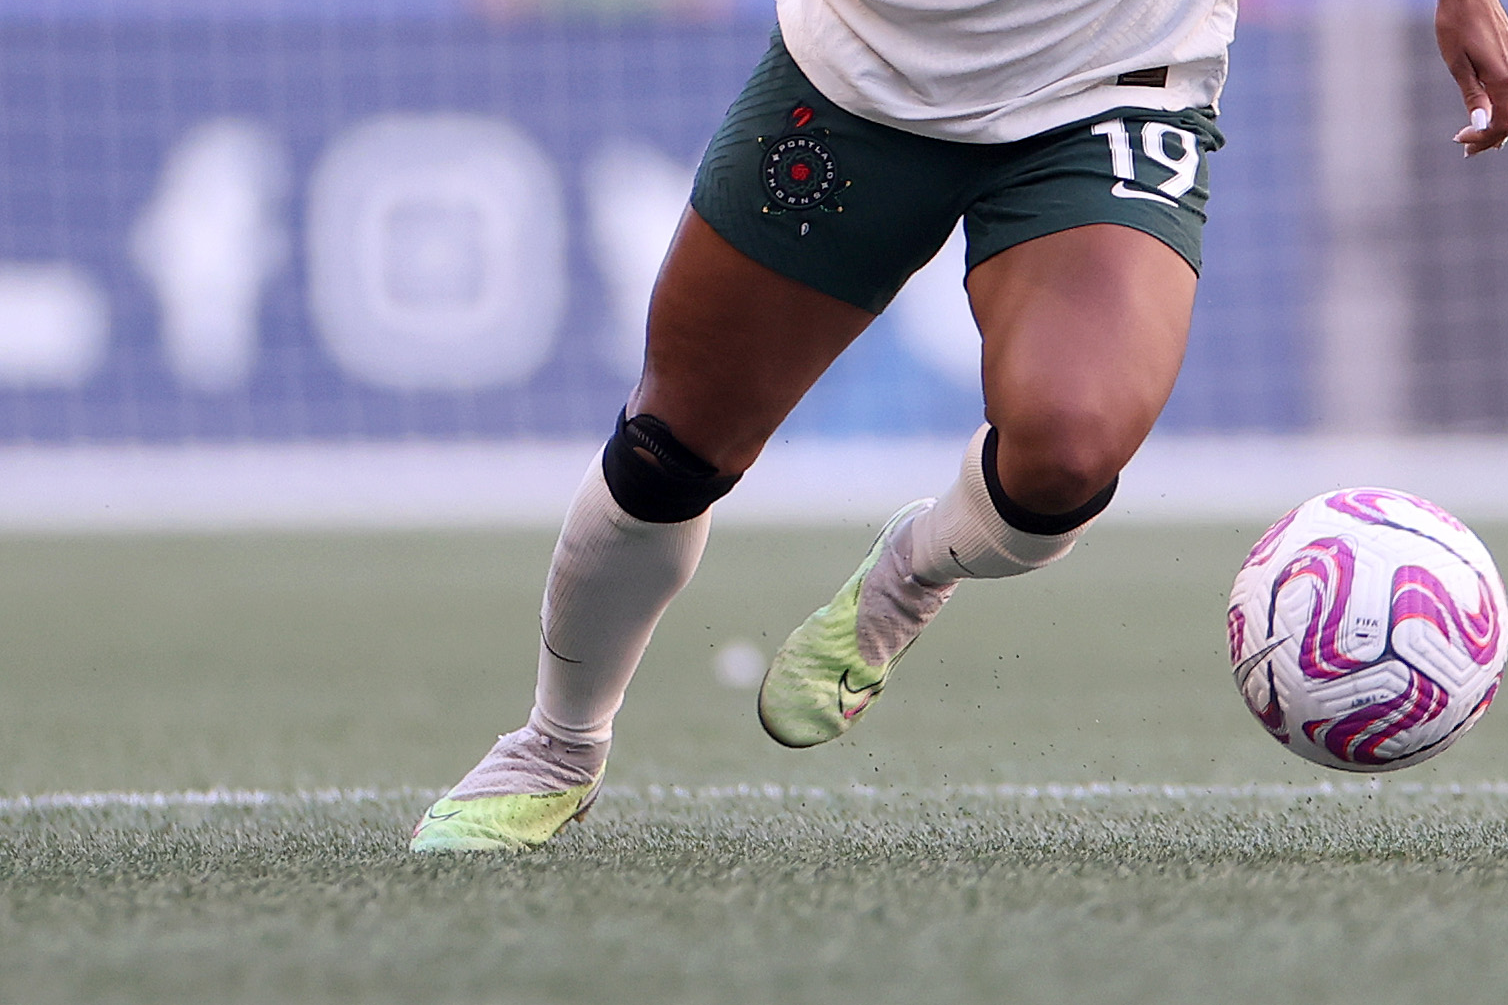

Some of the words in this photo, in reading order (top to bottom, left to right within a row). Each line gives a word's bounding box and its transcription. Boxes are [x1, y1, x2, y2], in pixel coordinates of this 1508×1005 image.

[778, 139, 834, 180] PORTLAND
[1091, 117, 1200, 199] 19
[767, 166, 821, 205] THORNS
